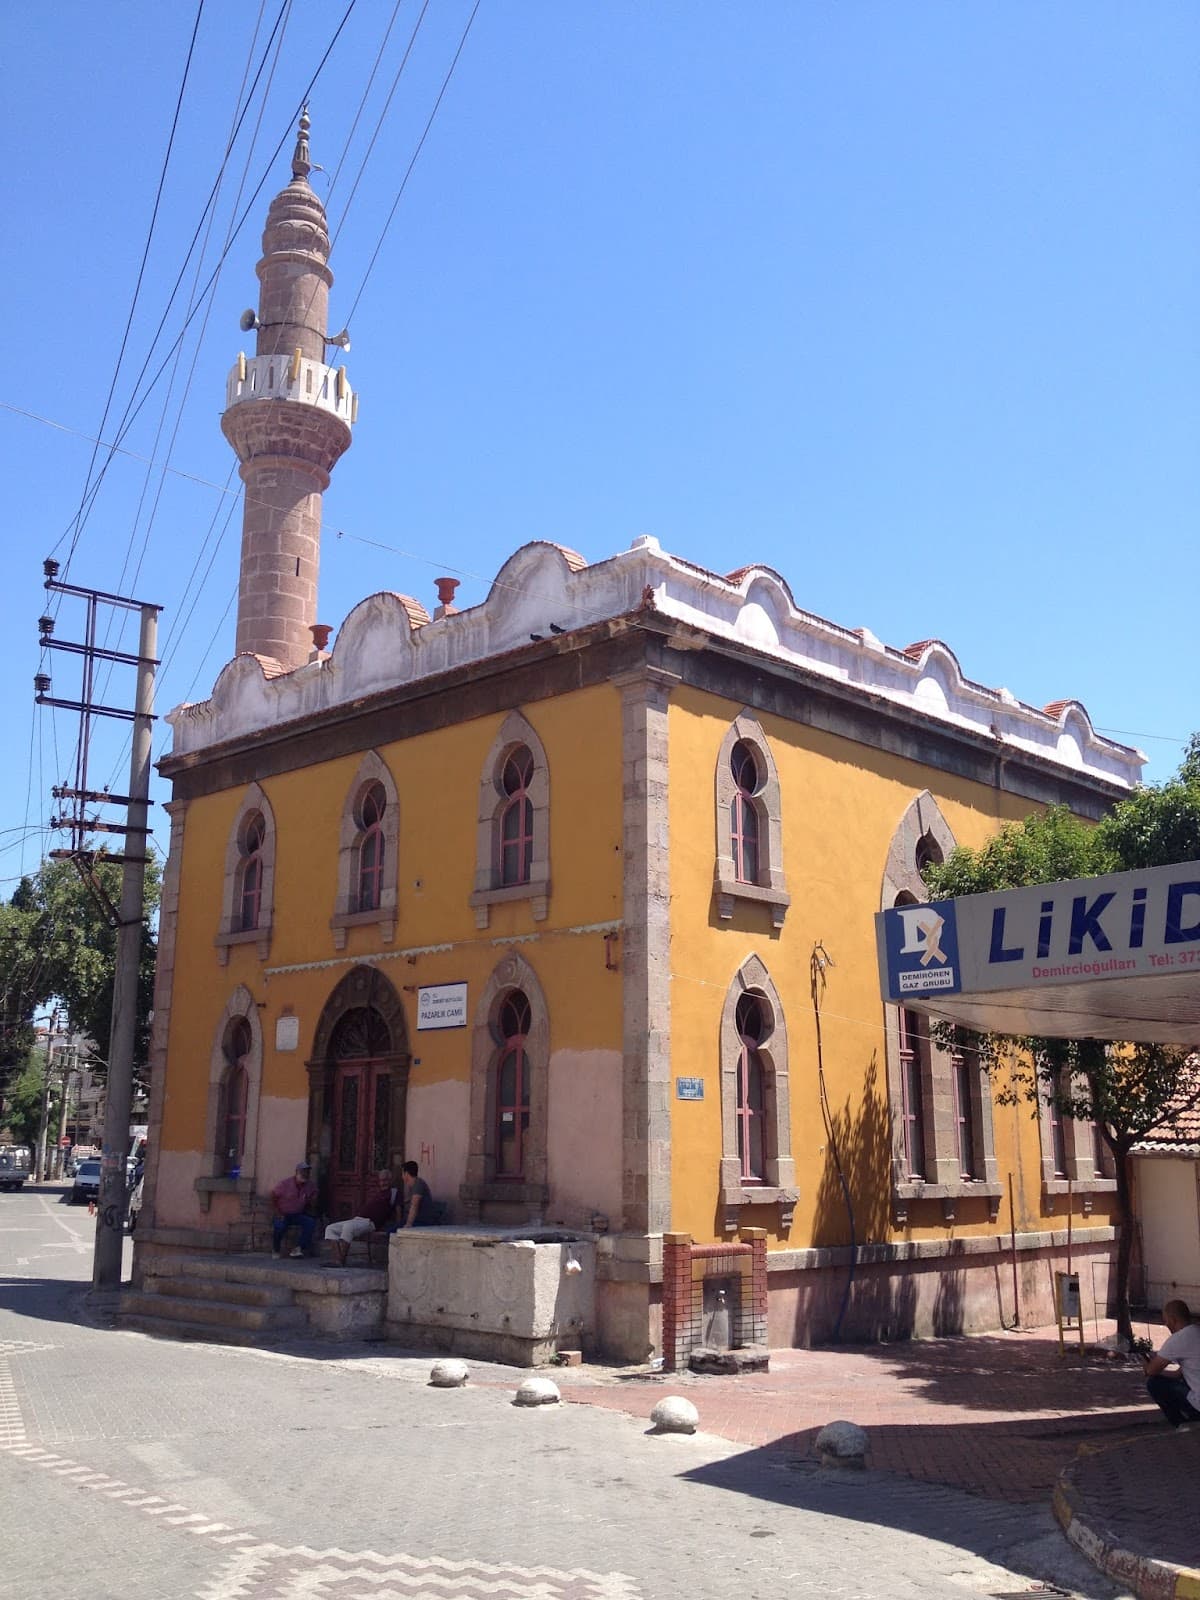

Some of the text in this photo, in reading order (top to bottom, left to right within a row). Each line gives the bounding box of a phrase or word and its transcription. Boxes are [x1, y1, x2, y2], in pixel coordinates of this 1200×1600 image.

[1032, 958, 1136, 978] Demircioğulları
[1148, 953, 1174, 967] Tel:
[902, 970, 950, 981] DEMİRÖREN
[923, 979, 951, 988] GRUBU
